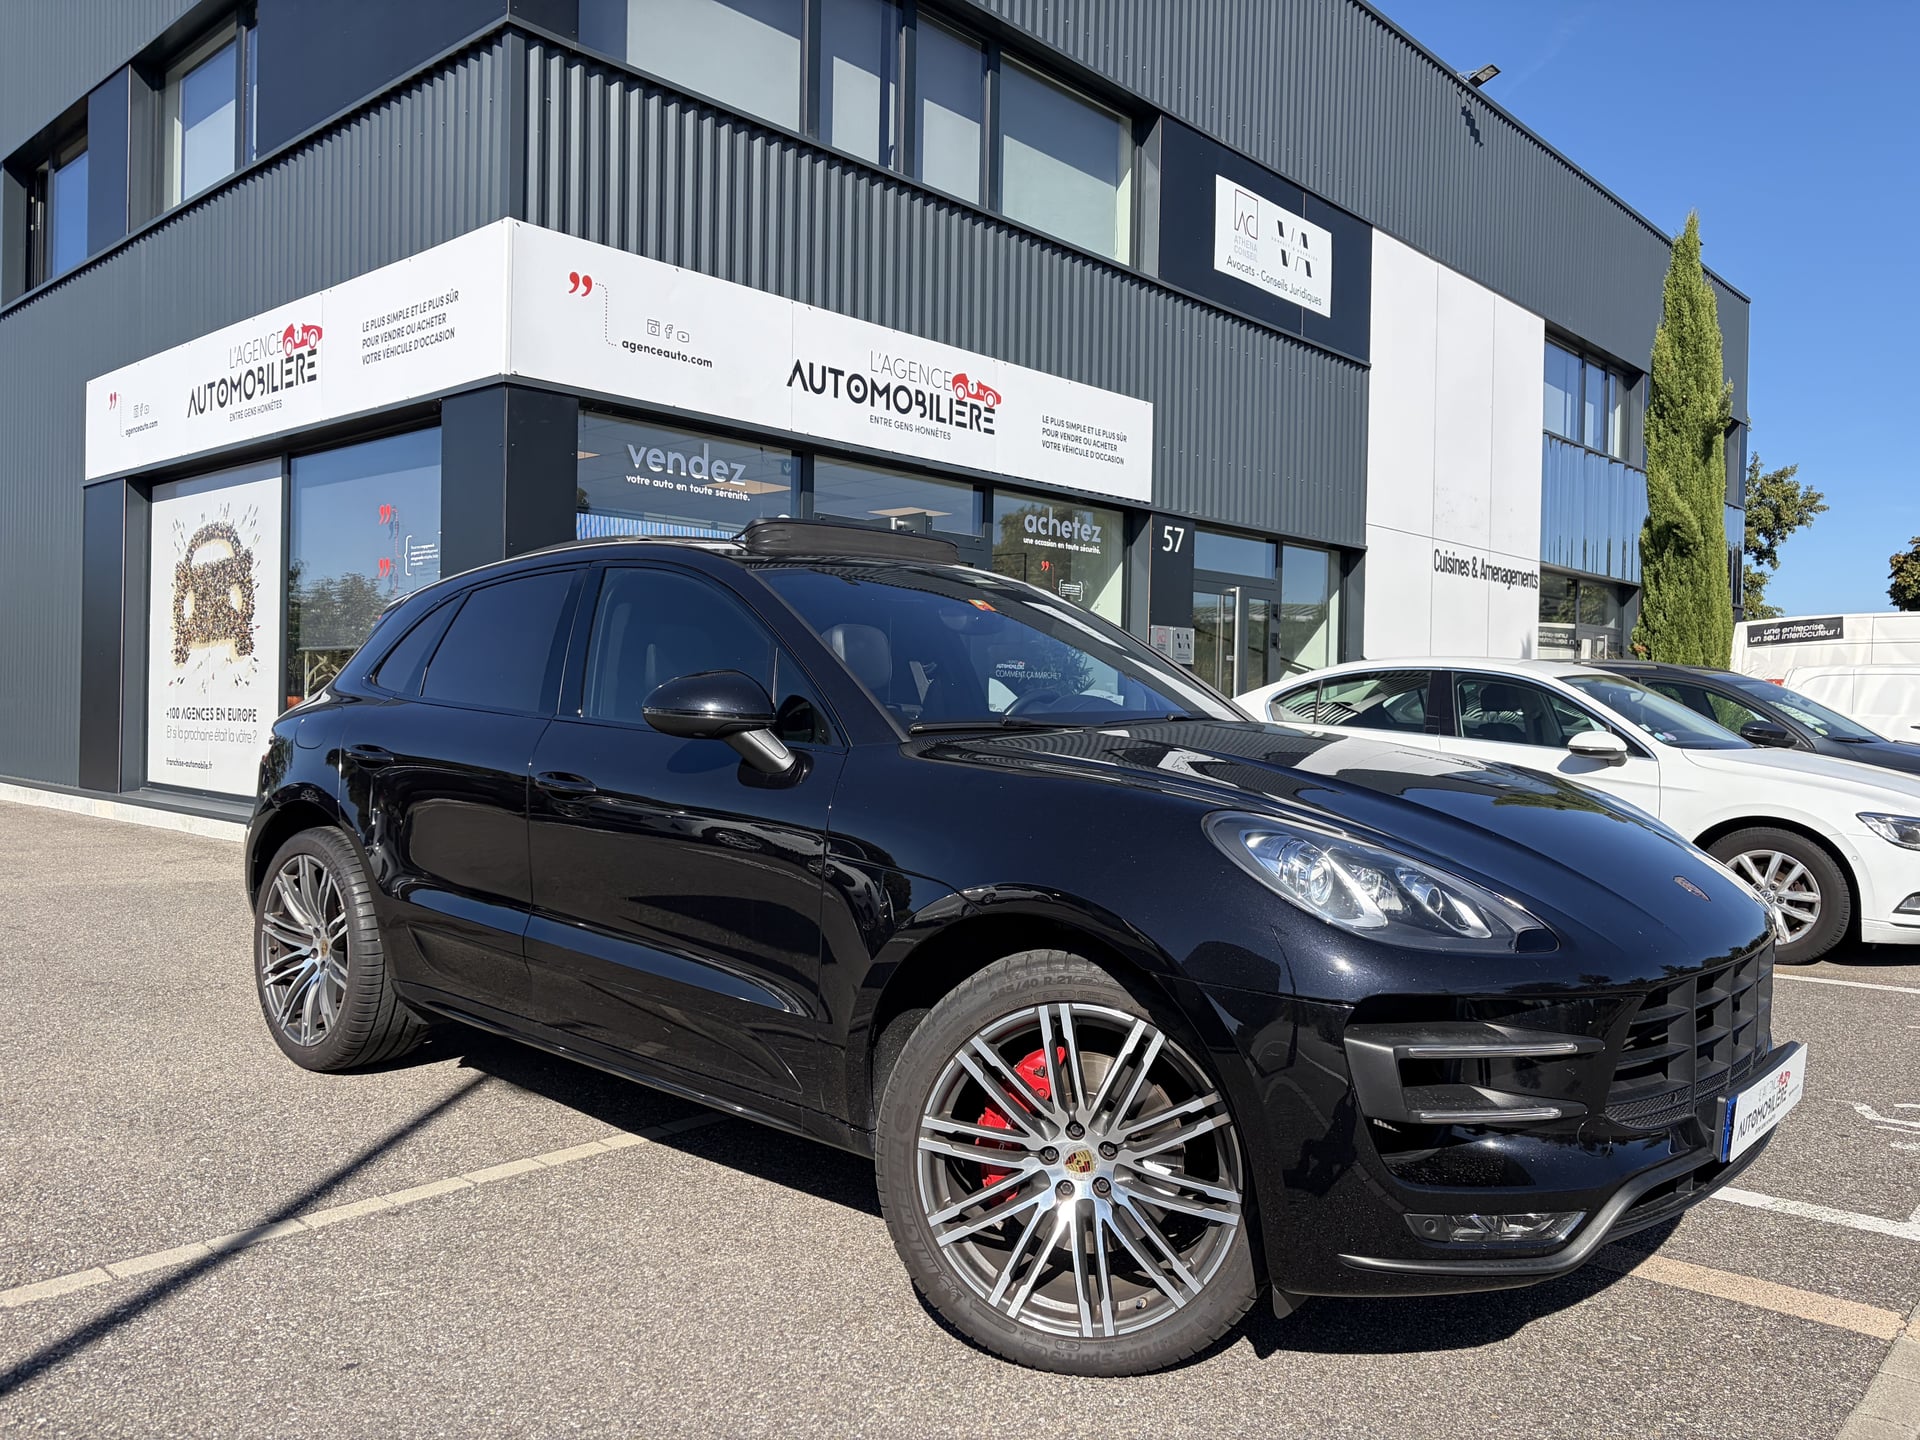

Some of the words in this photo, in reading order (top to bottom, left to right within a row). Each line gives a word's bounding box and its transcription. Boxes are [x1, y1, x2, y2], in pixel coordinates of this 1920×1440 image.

[1226, 255, 1255, 277] Avocats
[1260, 270, 1288, 292] Conseils
[1289, 282, 1322, 306] Juridiques
[362, 321, 369, 333] LE
[370, 315, 386, 330] PLUS
[386, 307, 410, 325] SIMPLE
[411, 304, 419, 317] ET
[420, 301, 427, 314] LE
[428, 295, 444, 311] PLUS
[362, 334, 380, 349] POUR
[380, 326, 405, 343] VENDRE
[405, 322, 416, 335] OU
[416, 312, 447, 332] ACHETER
[229, 330, 283, 369] L'AGENCE
[362, 350, 382, 365] VOTRE
[382, 340, 413, 359] VÉHICULE
[413, 326, 455, 350] D'OCCASION
[621, 340, 713, 368] agenceauto.com
[869, 350, 952, 392] L'AGENCE
[229, 409, 244, 422] ENTRE
[244, 405, 257, 418] GENS
[869, 414, 893, 428] ENTRE
[894, 420, 914, 432] GENS
[914, 425, 952, 440] HONNÊTES
[1042, 415, 1050, 424] LE
[1050, 416, 1065, 428] PLUS
[1065, 420, 1087, 433] SIMPLE
[1087, 425, 1094, 434] ET
[1095, 427, 1102, 437] LE
[1102, 429, 1116, 440] PLUS
[1042, 427, 1059, 438] POUR
[1059, 431, 1082, 444] VENDRE
[1082, 437, 1092, 446] OU
[1092, 439, 1118, 452] ACHETER
[627, 442, 746, 486] vendez
[1041, 439, 1061, 451] VOTRE
[1061, 442, 1089, 457] VÉHICULE
[1089, 450, 1125, 465] D'OCCASION
[625, 475, 651, 486] votre
[652, 478, 674, 489] auto
[676, 483, 687, 492] en
[689, 484, 713, 496] toute
[715, 487, 751, 502] sérénité.
[1024, 506, 1102, 543] achetez
[1023, 537, 1034, 545] une
[1034, 538, 1057, 548] occasion
[1065, 542, 1079, 551] toute
[1162, 525, 1185, 553] 57
[1433, 548, 1470, 577] Cuisines
[1471, 556, 1478, 579] &
[1750, 635, 1761, 643] un
[1763, 633, 1780, 642] seul
[1781, 629, 1835, 640] interlocuteur
[1763, 627, 1781, 635] une
[166, 706, 180, 719] +100
[181, 707, 214, 721] AGENCES
[216, 707, 226, 721] EN
[227, 707, 257, 723] EUROPE
[183, 726, 214, 743] prochaine
